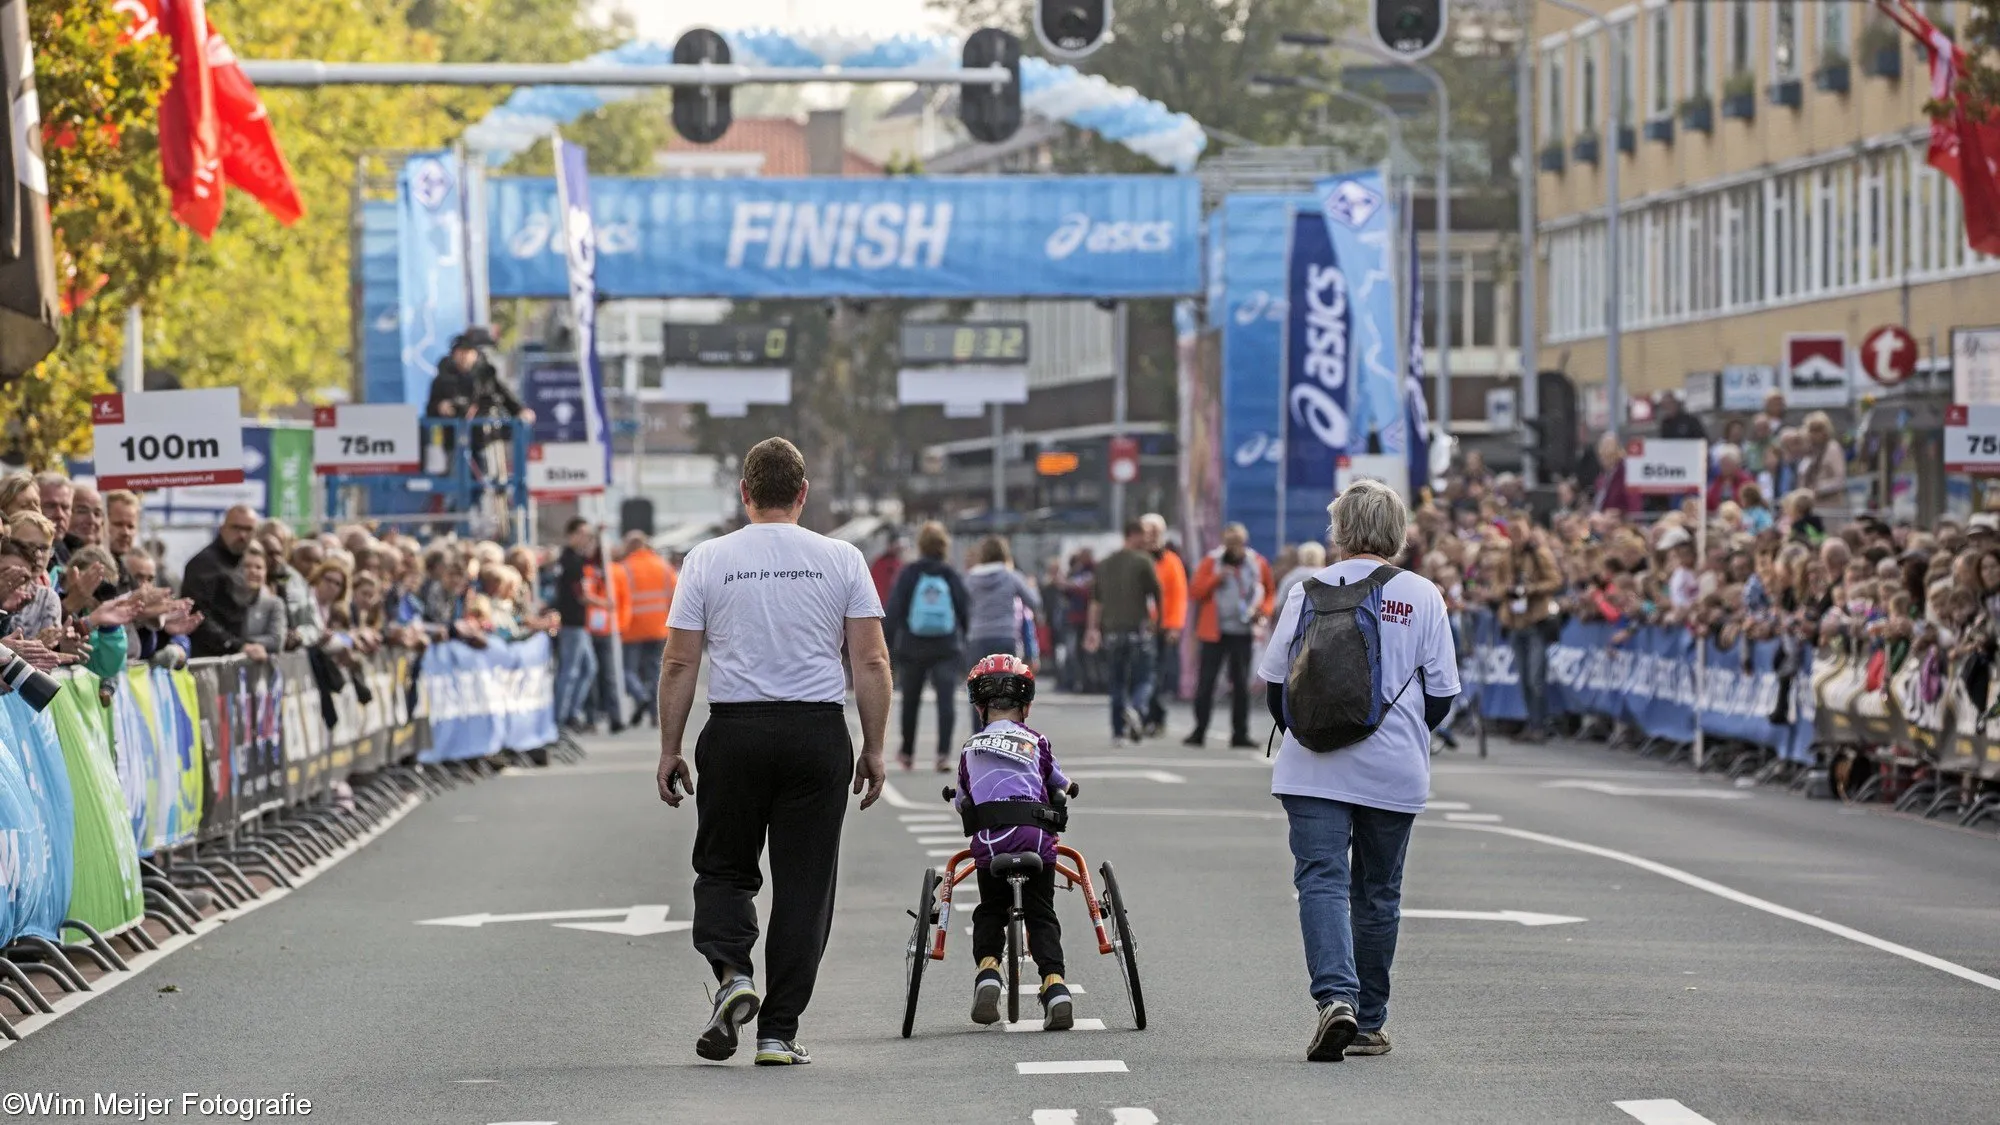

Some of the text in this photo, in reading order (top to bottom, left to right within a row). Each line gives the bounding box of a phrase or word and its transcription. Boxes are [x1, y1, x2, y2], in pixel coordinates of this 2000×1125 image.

[726, 202, 953, 267] FINISH
[1086, 221, 1174, 252] asics
[1305, 262, 1346, 390] asics
[1873, 329, 1904, 381] t
[120, 434, 219, 462] 100m
[339, 435, 395, 456] 75m
[1966, 434, 2000, 455] 75
[724, 569, 823, 585] ja kan je vergeten
[1400, 617, 1411, 627] JE!
[972, 738, 1019, 754] K6961
